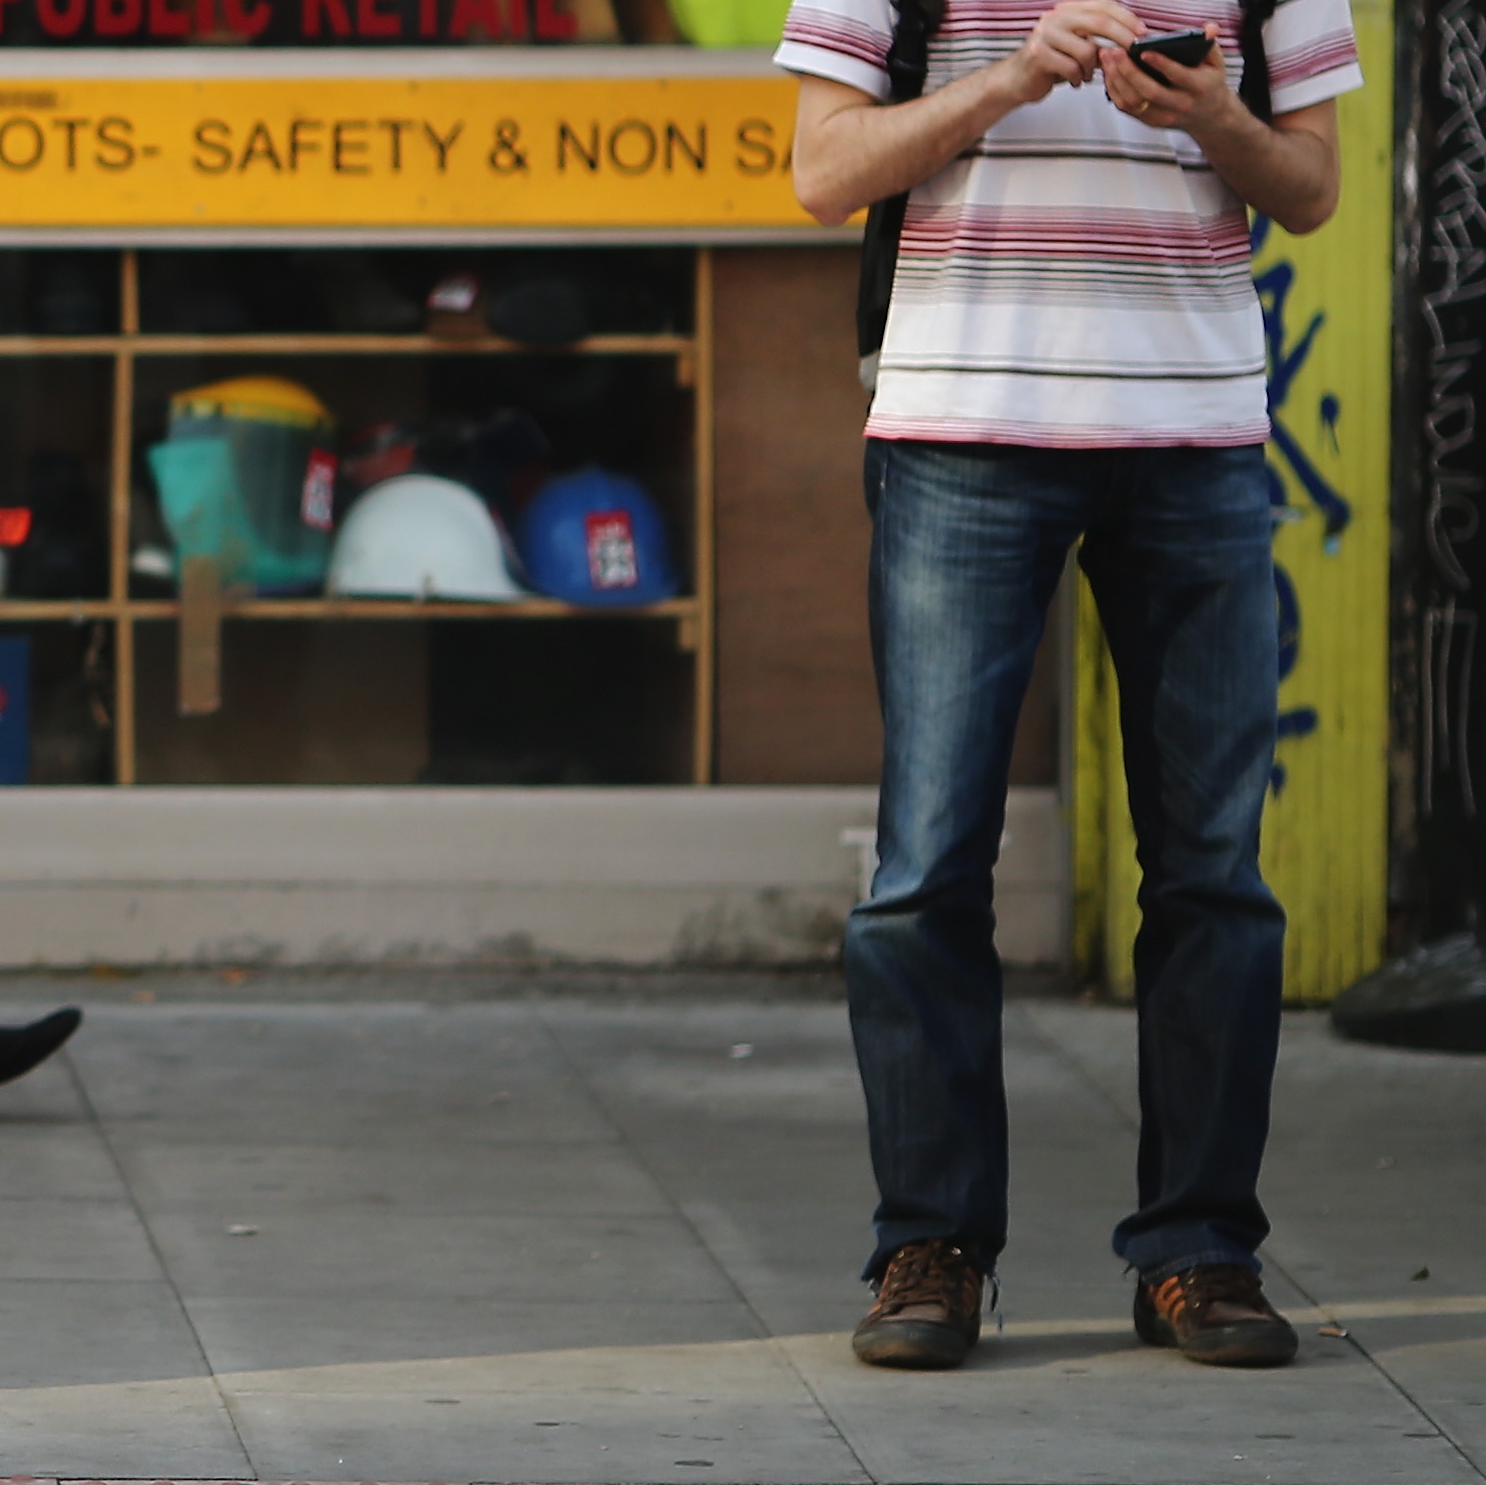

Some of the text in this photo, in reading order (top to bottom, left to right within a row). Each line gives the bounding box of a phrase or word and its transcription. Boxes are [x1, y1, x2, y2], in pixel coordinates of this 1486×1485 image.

[192, 117, 465, 174] SAFETY
[487, 117, 529, 174] &
[556, 118, 708, 175] NON
[736, 118, 793, 177] S
